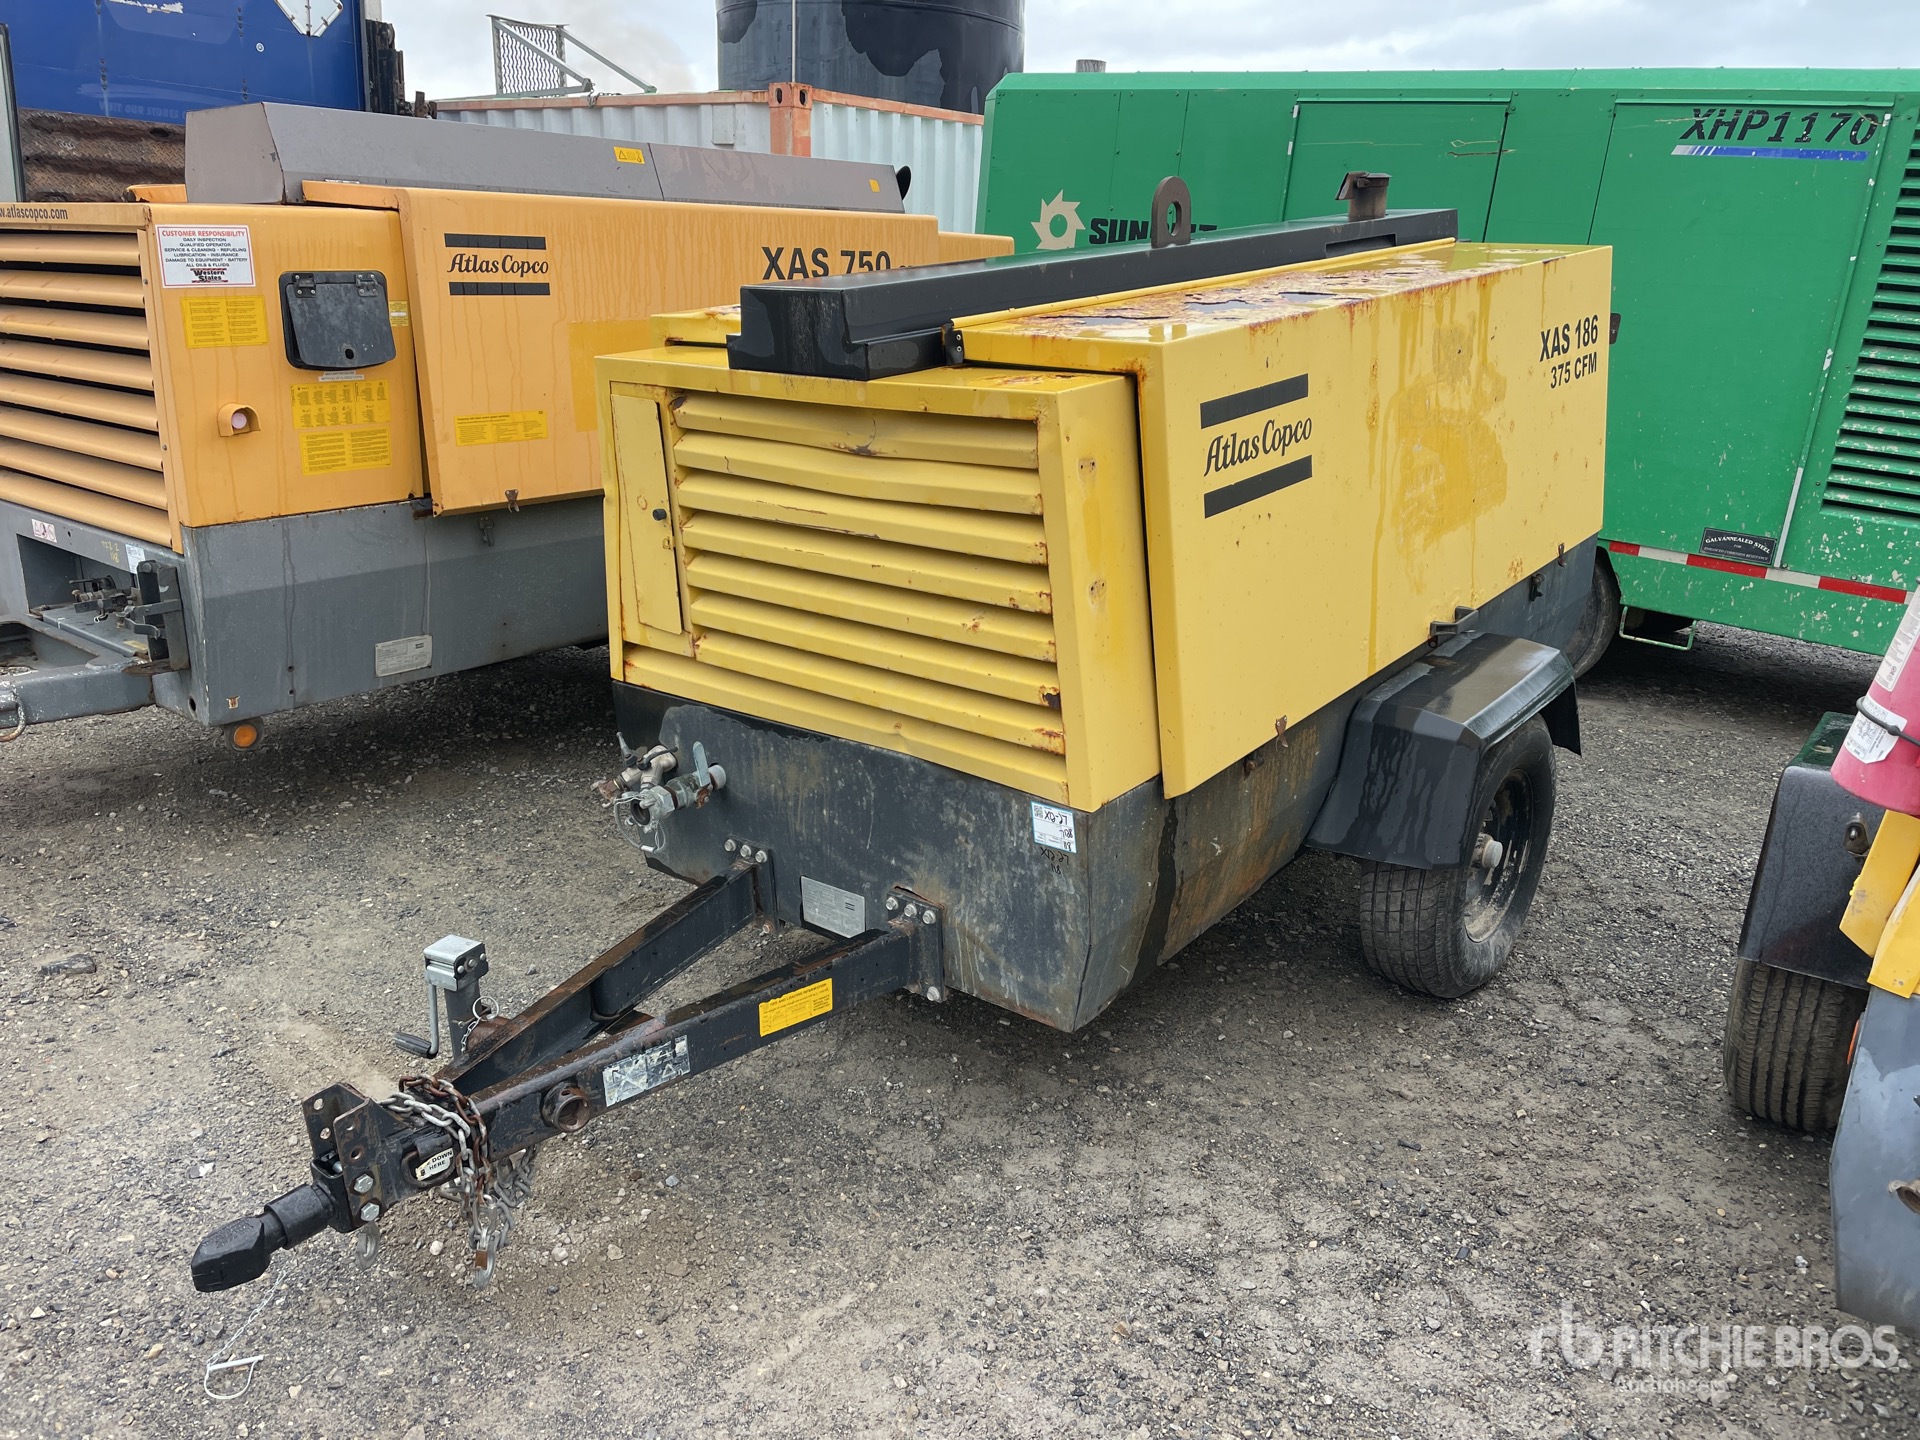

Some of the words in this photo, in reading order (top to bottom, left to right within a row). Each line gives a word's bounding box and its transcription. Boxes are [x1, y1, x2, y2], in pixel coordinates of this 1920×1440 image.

[1680, 108, 1879, 145] XHP1170
[447, 253, 499, 274] Atlas
[501, 254, 549, 278] Copco
[762, 246, 830, 280] XAS
[840, 250, 891, 274] 750
[1540, 323, 1571, 363] XAS
[1575, 314, 1599, 349] 186
[1550, 361, 1571, 389] 375
[1574, 351, 1597, 380] CFM
[1203, 432, 1260, 477] Atlas
[1262, 417, 1312, 457] Copco
[1705, 536, 1754, 545] GALVANNEALED
[1753, 541, 1771, 554] STEEL
[429, 1160, 446, 1170] HERE
[431, 1150, 453, 1163] DOWN
